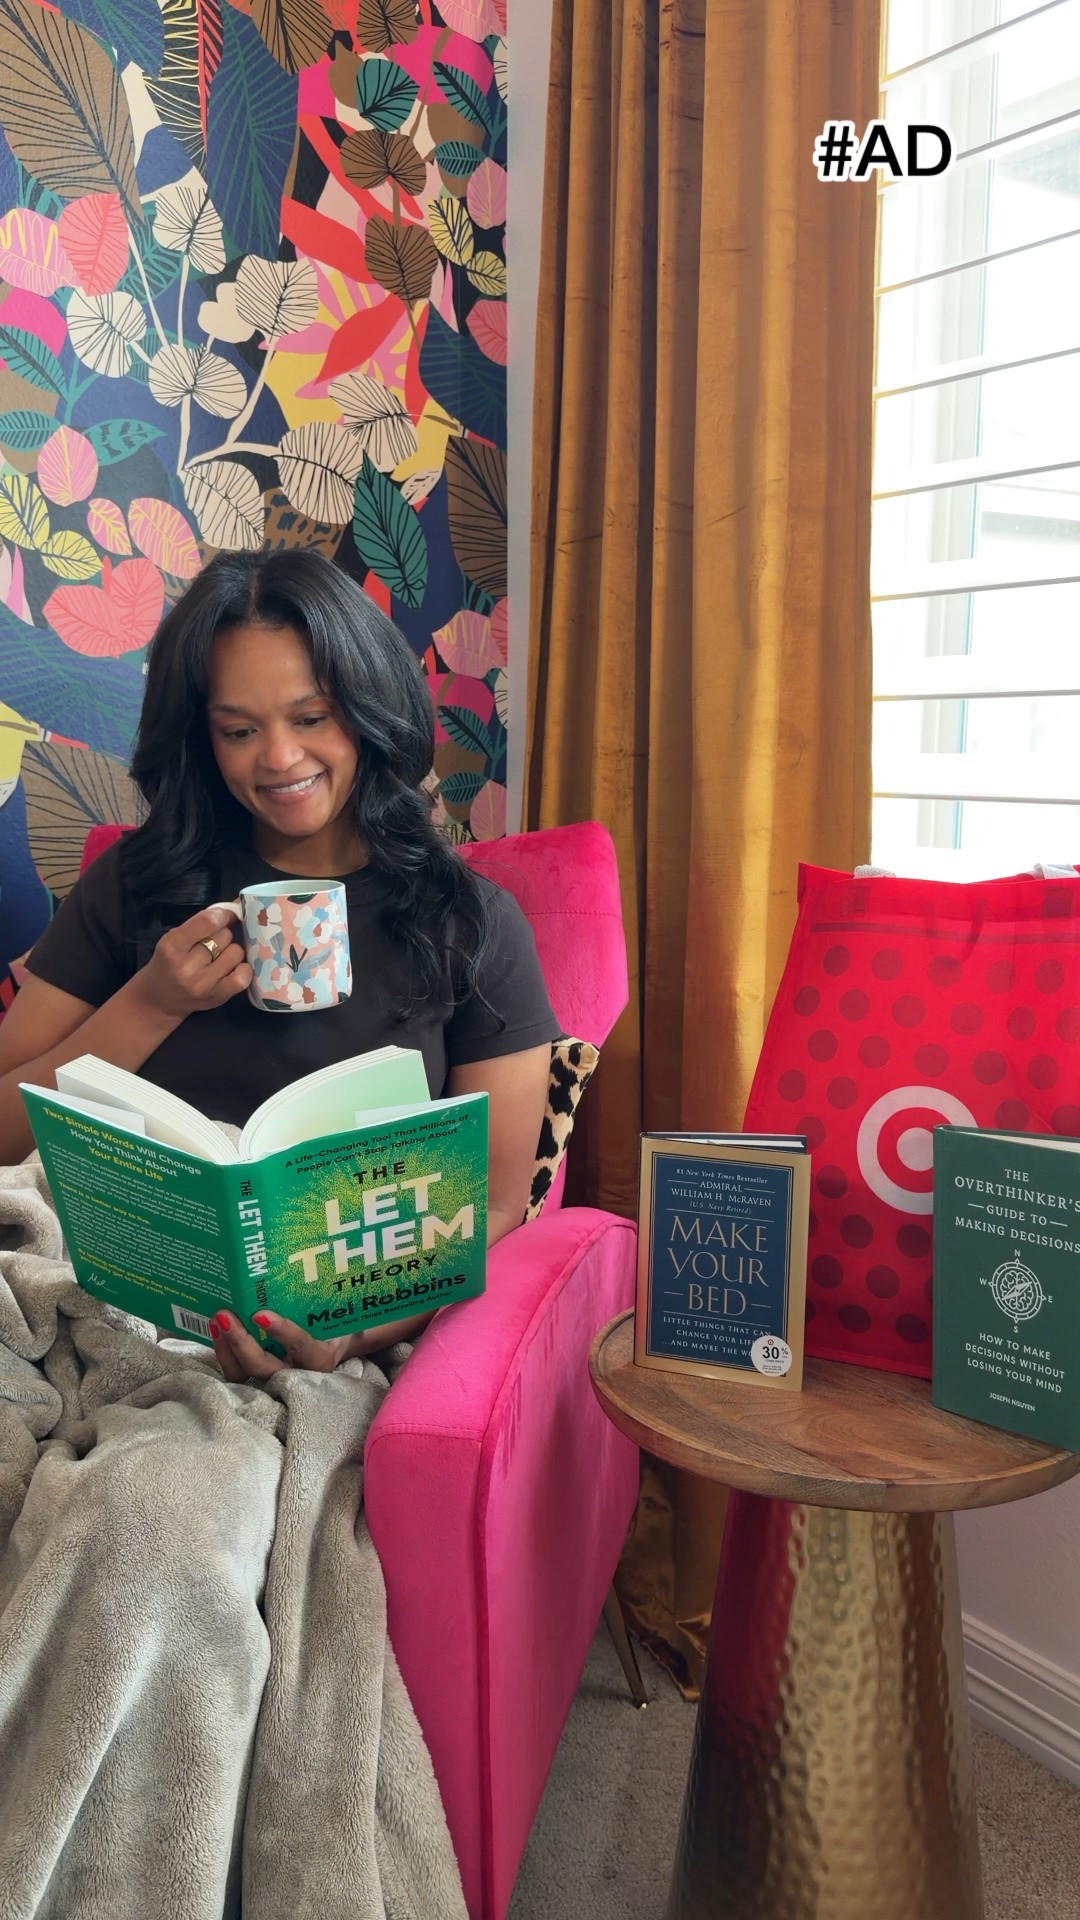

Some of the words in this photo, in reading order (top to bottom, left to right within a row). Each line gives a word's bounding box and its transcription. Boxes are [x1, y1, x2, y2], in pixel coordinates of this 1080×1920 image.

[43, 1107, 64, 1120] Two
[65, 1116, 99, 1136] Simple
[101, 1131, 134, 1150] Words
[136, 1145, 156, 1158] Will
[159, 1154, 201, 1175] Change
[371, 1133, 391, 1143] Tool
[394, 1128, 417, 1138] That
[420, 1118, 456, 1131] Millions
[458, 1114, 469, 1122] of
[70, 1128, 92, 1143] How
[94, 1138, 113, 1152] You
[115, 1147, 143, 1164] Think
[145, 1160, 177, 1176] About
[88, 1146, 111, 1160] Your
[113, 1156, 142, 1173] Entire
[145, 1169, 163, 1181] Life
[297, 1160, 332, 1174] People
[334, 1151, 362, 1163] Can't
[364, 1146, 388, 1156] Stop
[390, 1136, 426, 1149] Talking
[428, 1128, 458, 1140] About
[353, 1161, 406, 1184] THE
[700, 1181, 743, 1192] ADMIRAL
[737, 1174, 768, 1184] Bestseller
[1005, 1169, 1029, 1182] THE
[240, 1180, 252, 1197] THE
[671, 1188, 712, 1199] WILLIAM
[728, 1195, 771, 1206] McRAVEN
[955, 1176, 1080, 1213] OVERTHINKER'S
[238, 1199, 262, 1227] LET
[325, 1172, 442, 1237] LET
[986, 1205, 1025, 1221] GUIDE
[1031, 1214, 1047, 1225] TO
[288, 1203, 474, 1284] THEM
[670, 1215, 768, 1253] MAKE
[955, 1216, 1005, 1236] MAKING
[1010, 1229, 1080, 1254] DECISIONS
[243, 1231, 269, 1277] THEM
[667, 1248, 769, 1287] YOUR
[1014, 1249, 1020, 1257] N
[333, 1254, 437, 1291] THEORY
[979, 1278, 987, 1286] W
[255, 1279, 267, 1308] THEORY
[307, 1301, 354, 1327] Mel
[362, 1274, 466, 1310] Robbins
[688, 1283, 746, 1316] BED
[663, 1316, 690, 1326] LITTLE
[694, 1321, 725, 1330] THINGS
[728, 1326, 750, 1334] THAT
[676, 1330, 710, 1340] CHANGE
[713, 1335, 736, 1344] YOUR
[691, 1342, 718, 1352] MAYBE
[722, 1347, 737, 1355] THE
[965, 1343, 1016, 1364] DECISIONS
[1020, 1359, 1065, 1379] WITHOUT
[979, 1333, 1003, 1345] HOW
[1007, 1340, 1019, 1350] TO
[1023, 1345, 1051, 1360] MAKE
[967, 1358, 1002, 1375] LOSING
[1006, 1369, 1032, 1384] YOUR
[1036, 1378, 1062, 1393] MIND
[990, 1392, 1010, 1404] JOSEPH
[1011, 1399, 1036, 1412] NGUYEN
